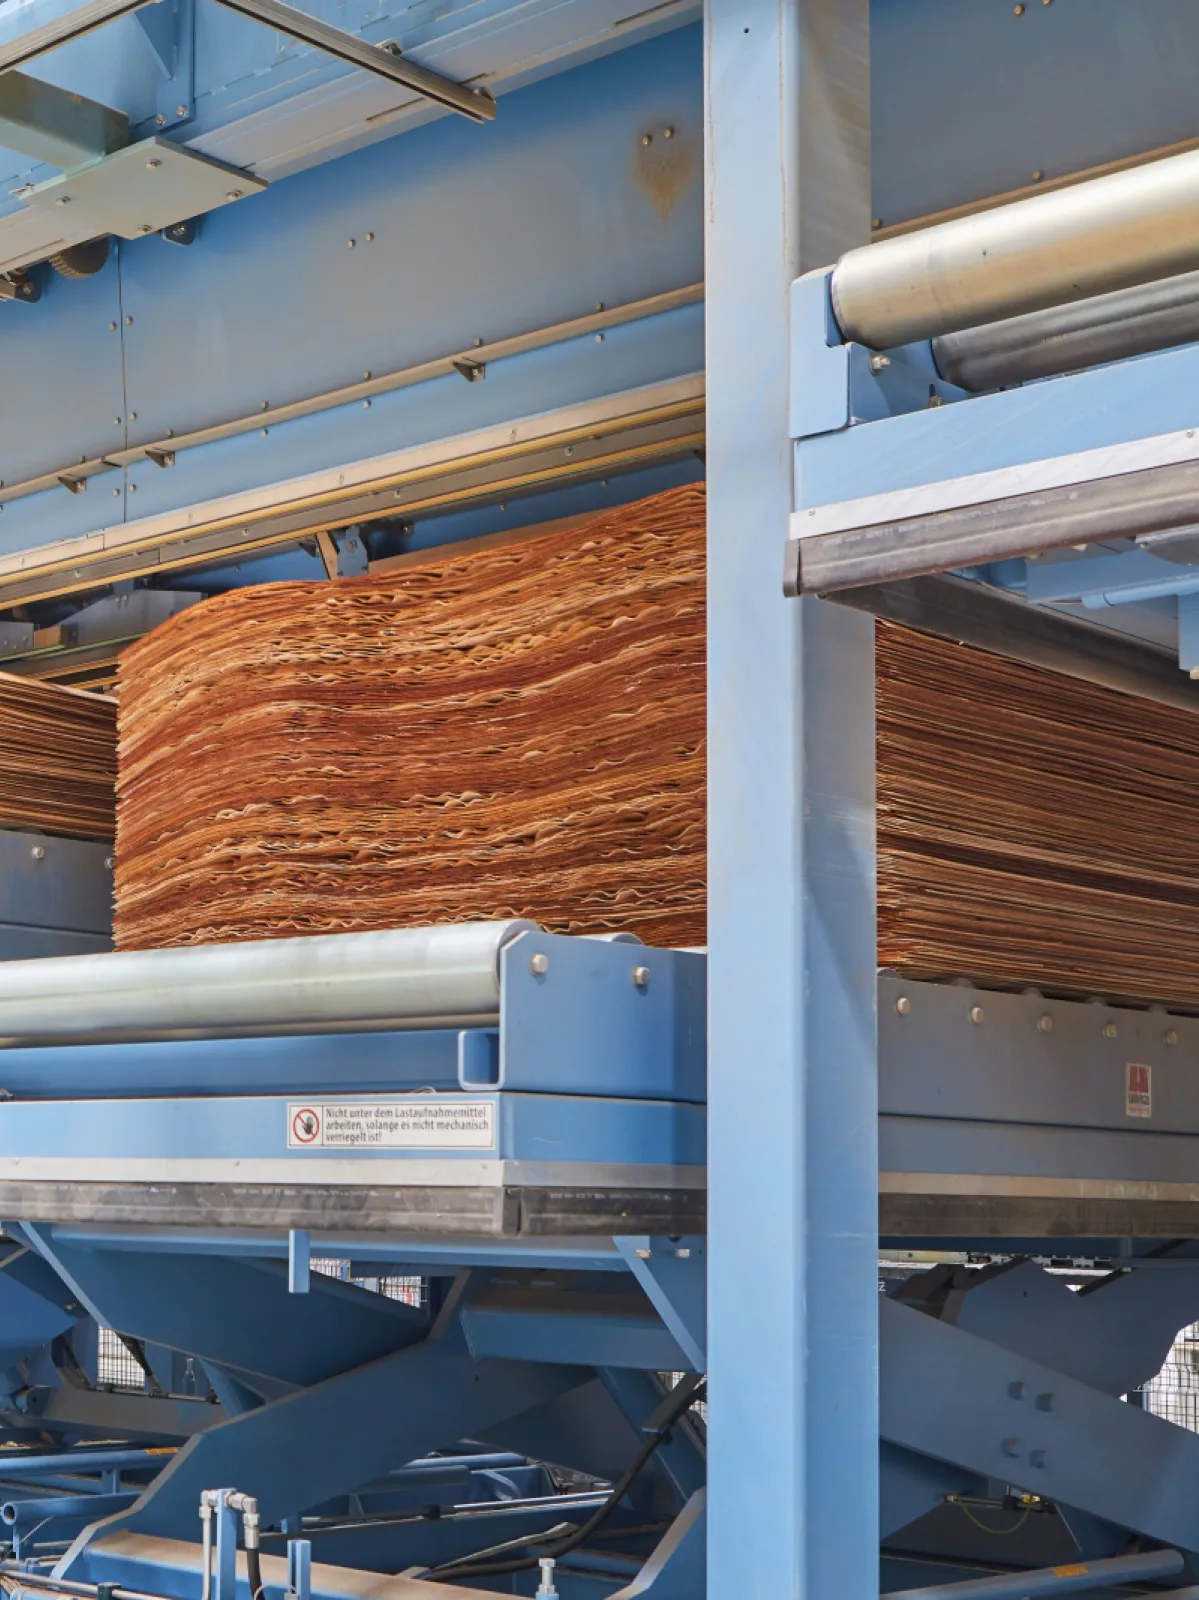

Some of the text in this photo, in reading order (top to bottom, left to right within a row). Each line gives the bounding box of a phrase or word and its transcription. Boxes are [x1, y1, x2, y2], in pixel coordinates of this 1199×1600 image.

[326, 1106, 486, 1118] Nicht unter dem Lastaufnahmemittel
[326, 1119, 489, 1133] arbeiten, solange es nicht mechanisch
[326, 1131, 382, 1145] verriegelt ist!
